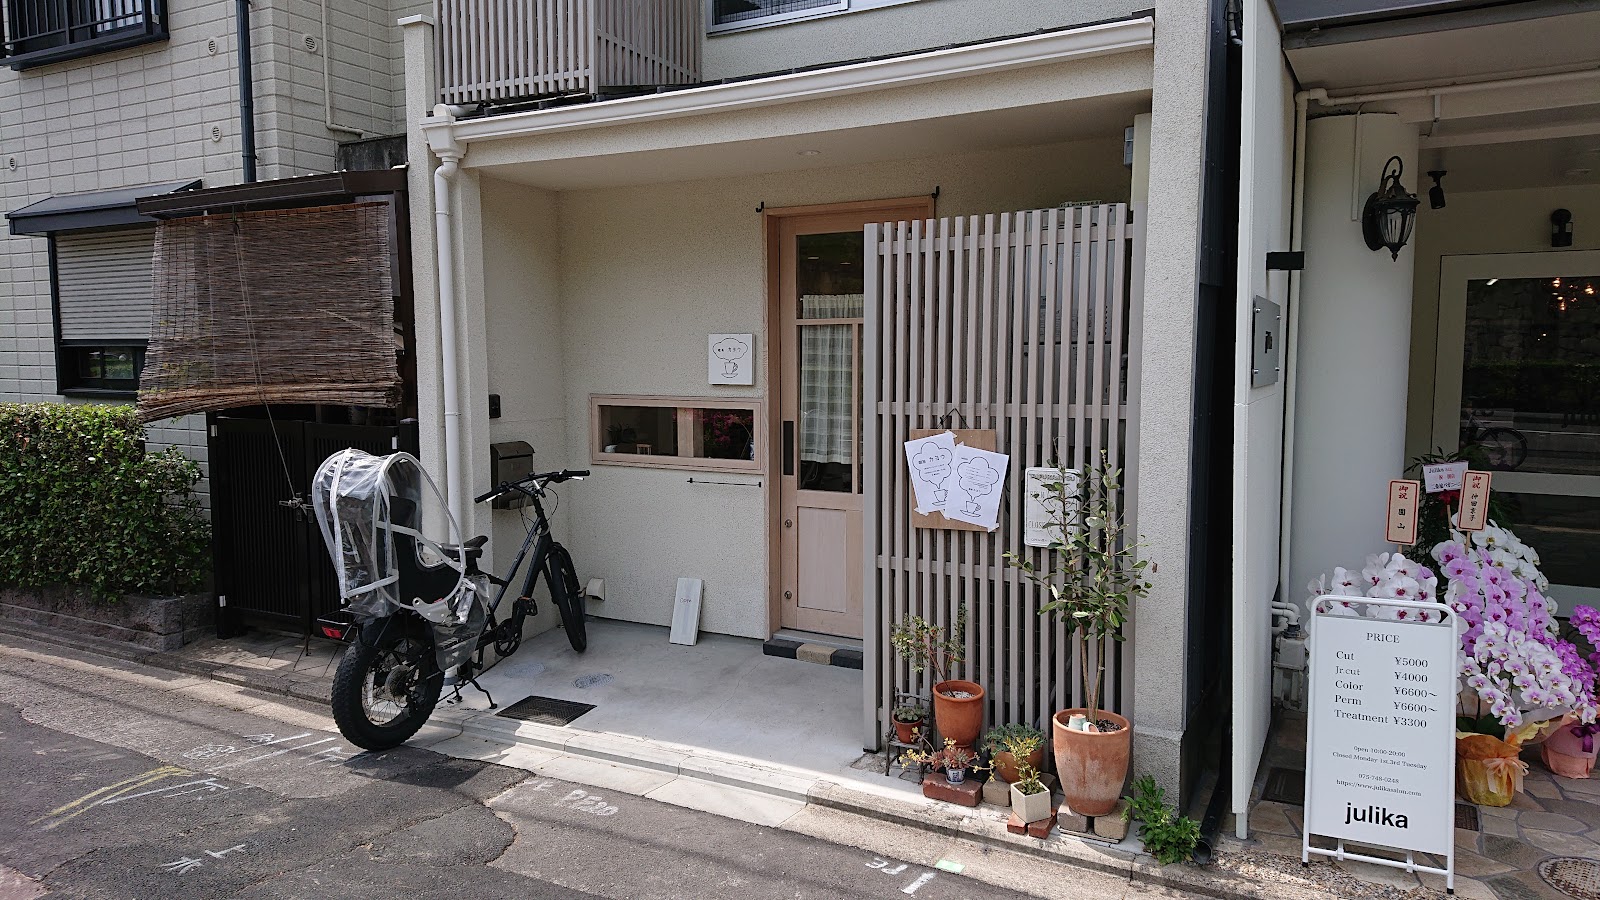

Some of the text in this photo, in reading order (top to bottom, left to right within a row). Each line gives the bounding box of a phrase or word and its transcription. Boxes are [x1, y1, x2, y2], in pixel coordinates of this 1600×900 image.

[1366, 632, 1400, 643] PRICE
[1336, 650, 1428, 668] Cut ¥5000
[1335, 666, 1428, 683] Jr.cut ¥4000
[1335, 680, 1363, 690] Color
[1334, 694, 1362, 705] Perm
[1334, 709, 1427, 728] Treatment ¥3300
[1353, 754, 1378, 763] Monday
[1402, 761, 1427, 770] Tuesday
[1345, 802, 1408, 829] julika
